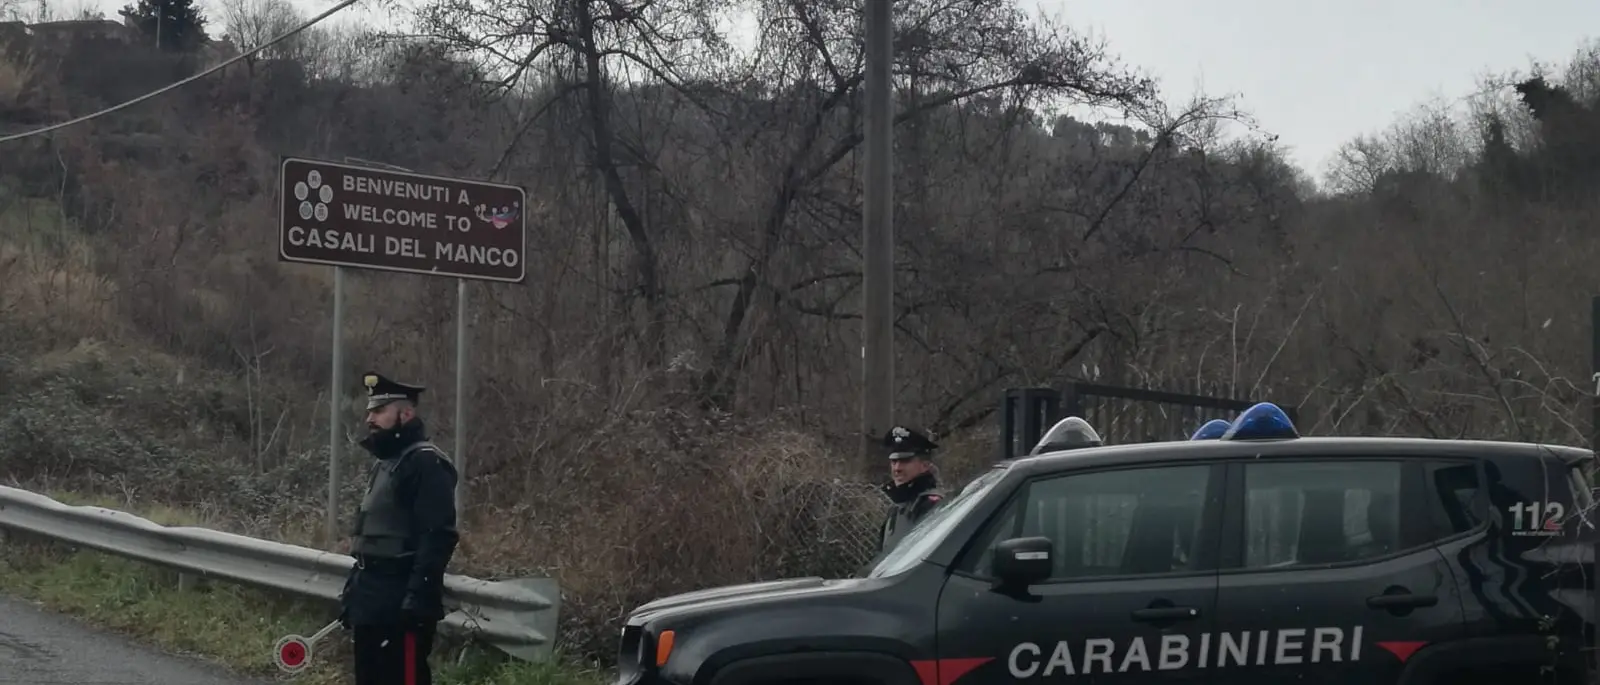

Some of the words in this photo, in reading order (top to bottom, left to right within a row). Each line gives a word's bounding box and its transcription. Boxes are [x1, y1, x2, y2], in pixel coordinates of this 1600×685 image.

[343, 175, 450, 203] BENVENUTI
[458, 189, 470, 206] A
[343, 203, 437, 229] WELCOME
[445, 215, 471, 232] TO
[288, 226, 375, 254] CASALI
[385, 236, 426, 258] DEL
[436, 241, 518, 267] MANCO
[1508, 501, 1564, 530] 112
[1008, 625, 1364, 679] CARABINIERI
